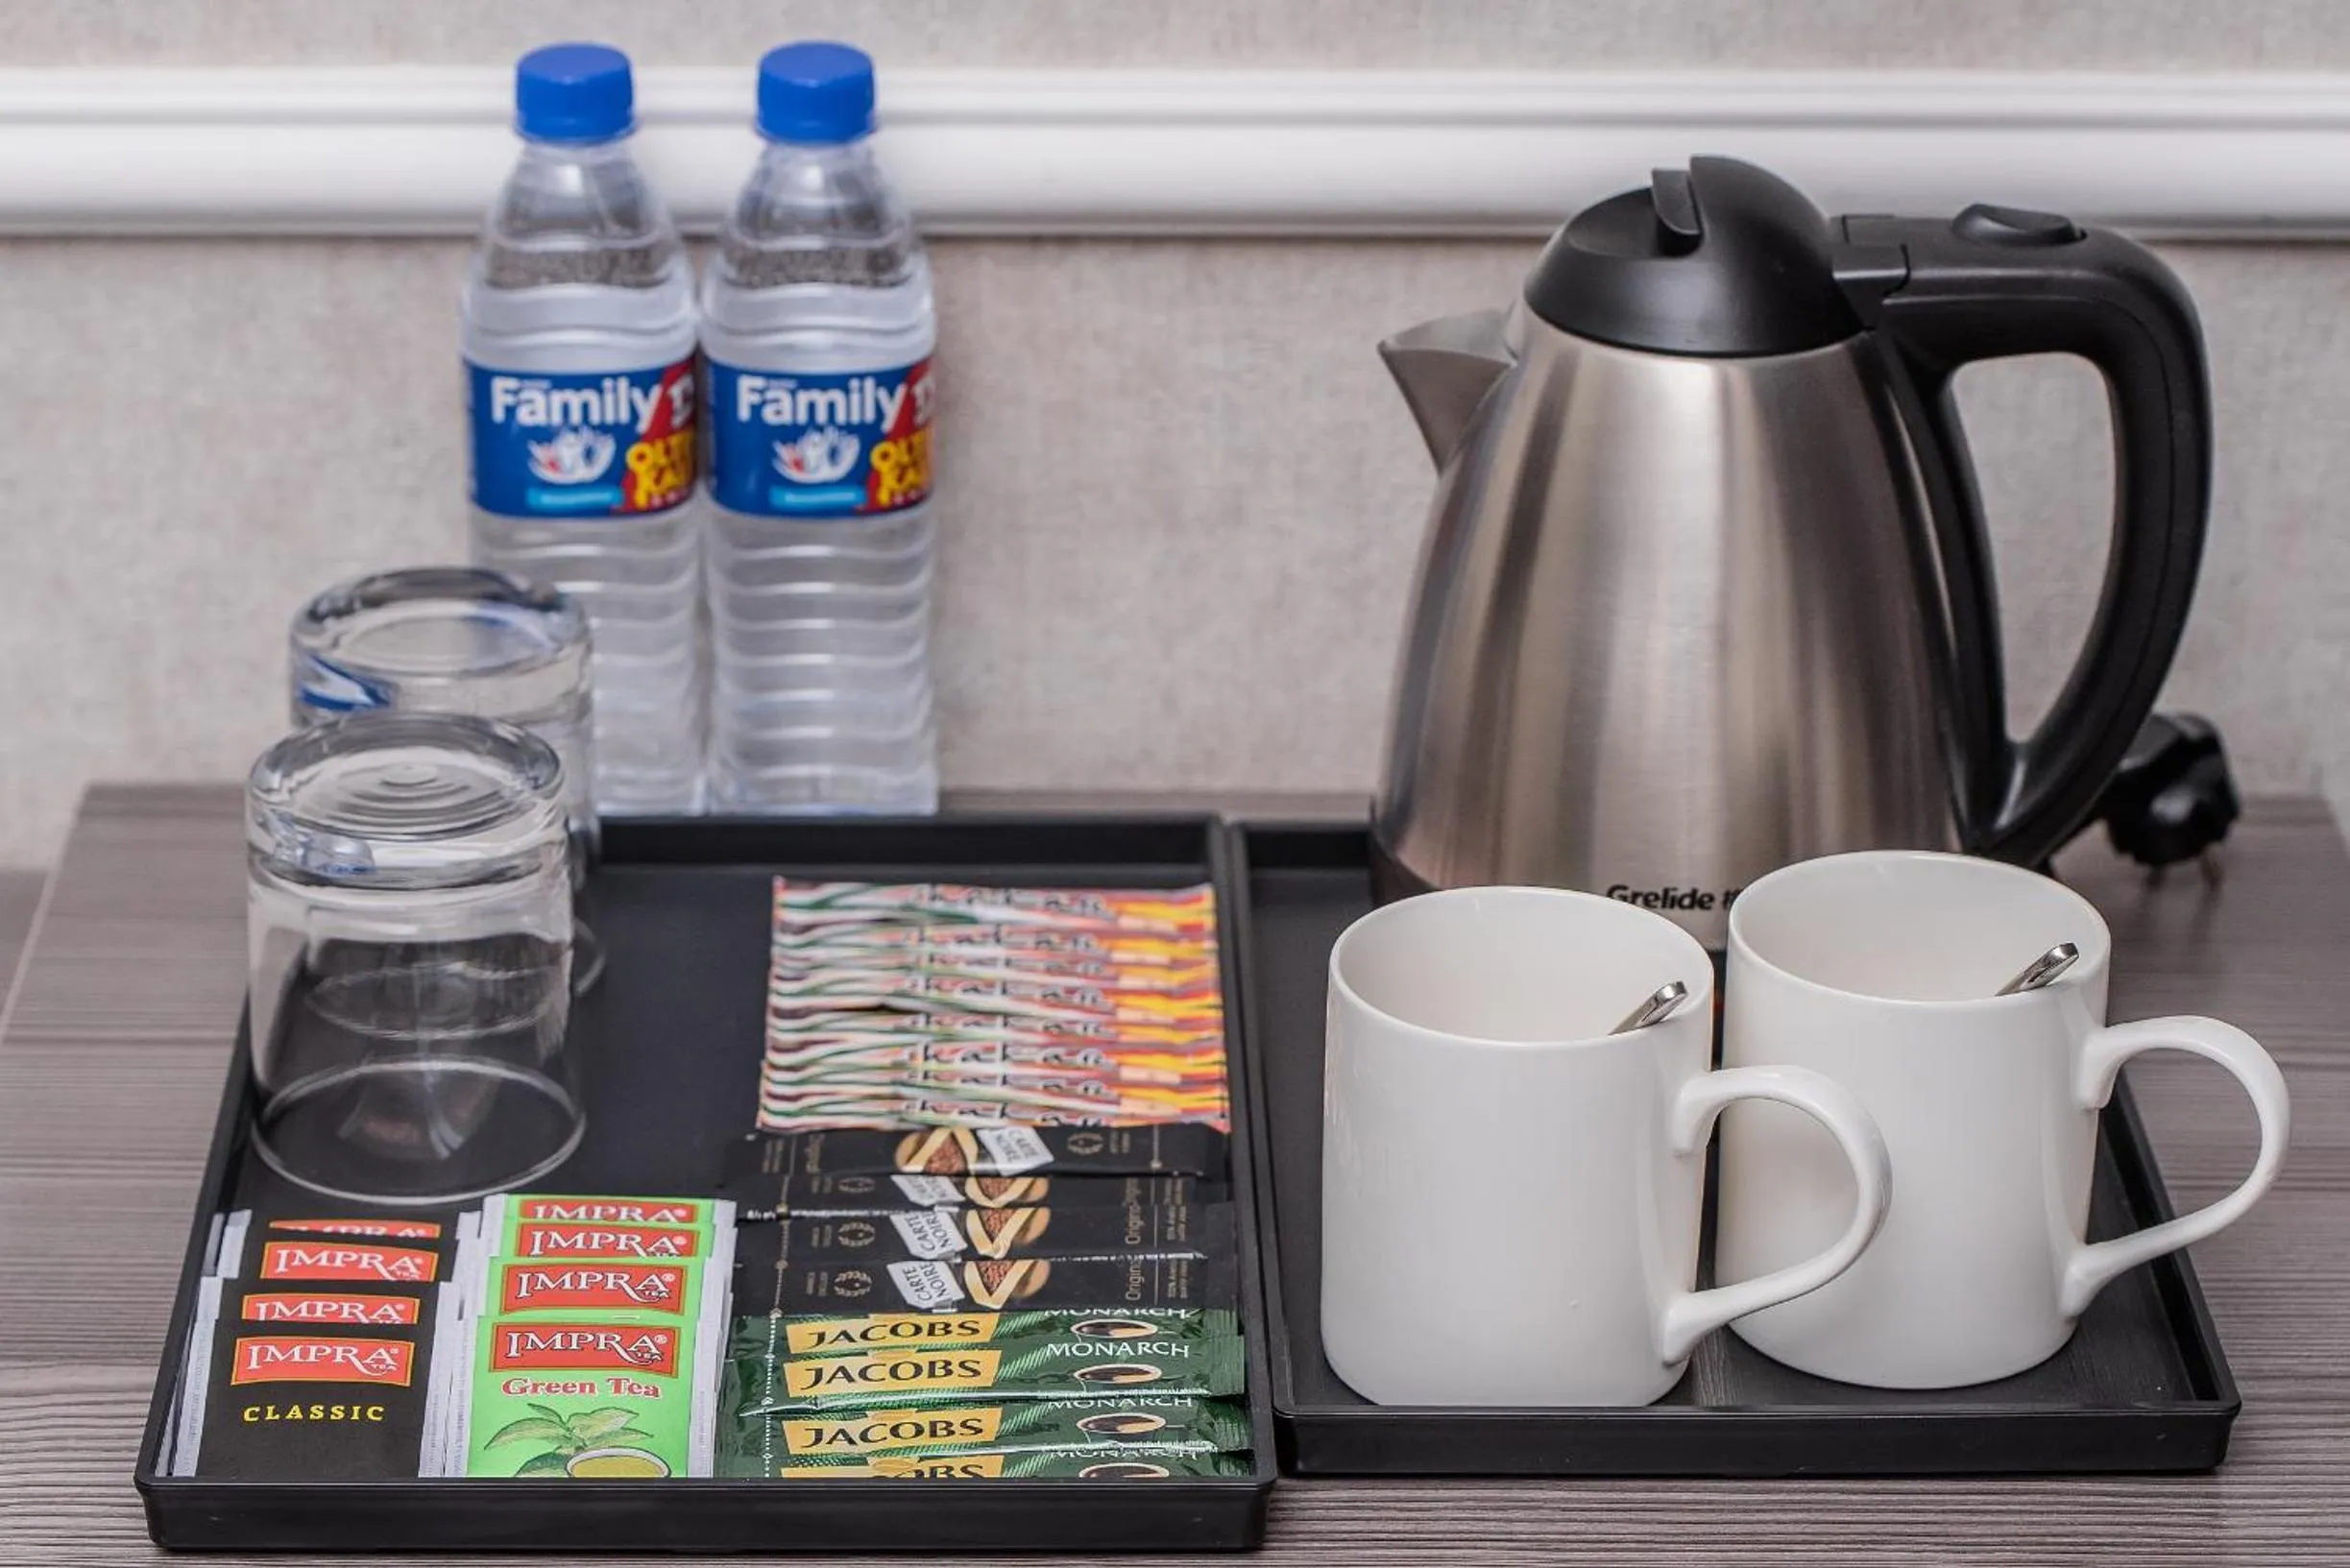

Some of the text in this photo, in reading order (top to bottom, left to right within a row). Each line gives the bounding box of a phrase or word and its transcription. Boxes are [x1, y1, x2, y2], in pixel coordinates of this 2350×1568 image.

[491, 376, 663, 434] Family
[737, 374, 908, 434] Family
[1607, 884, 1715, 910] Grelide
[530, 1231, 681, 1258] IMPRA
[905, 1214, 935, 1252] CARTE
[275, 1249, 421, 1281] IMPRA
[920, 1262, 948, 1298] NOIRE
[516, 1271, 670, 1303] IMPRA
[903, 1265, 933, 1302] CARTE
[505, 1332, 664, 1365] IMPRA
[806, 1320, 981, 1349] JACOBS
[1045, 1341, 1190, 1359] MONARCH
[247, 1345, 397, 1376] IMPRA
[800, 1359, 981, 1390] JACOBS
[502, 1378, 662, 1398] Green Tea
[243, 1404, 385, 1422] CLASSIC
[800, 1418, 984, 1448] JACOBS
